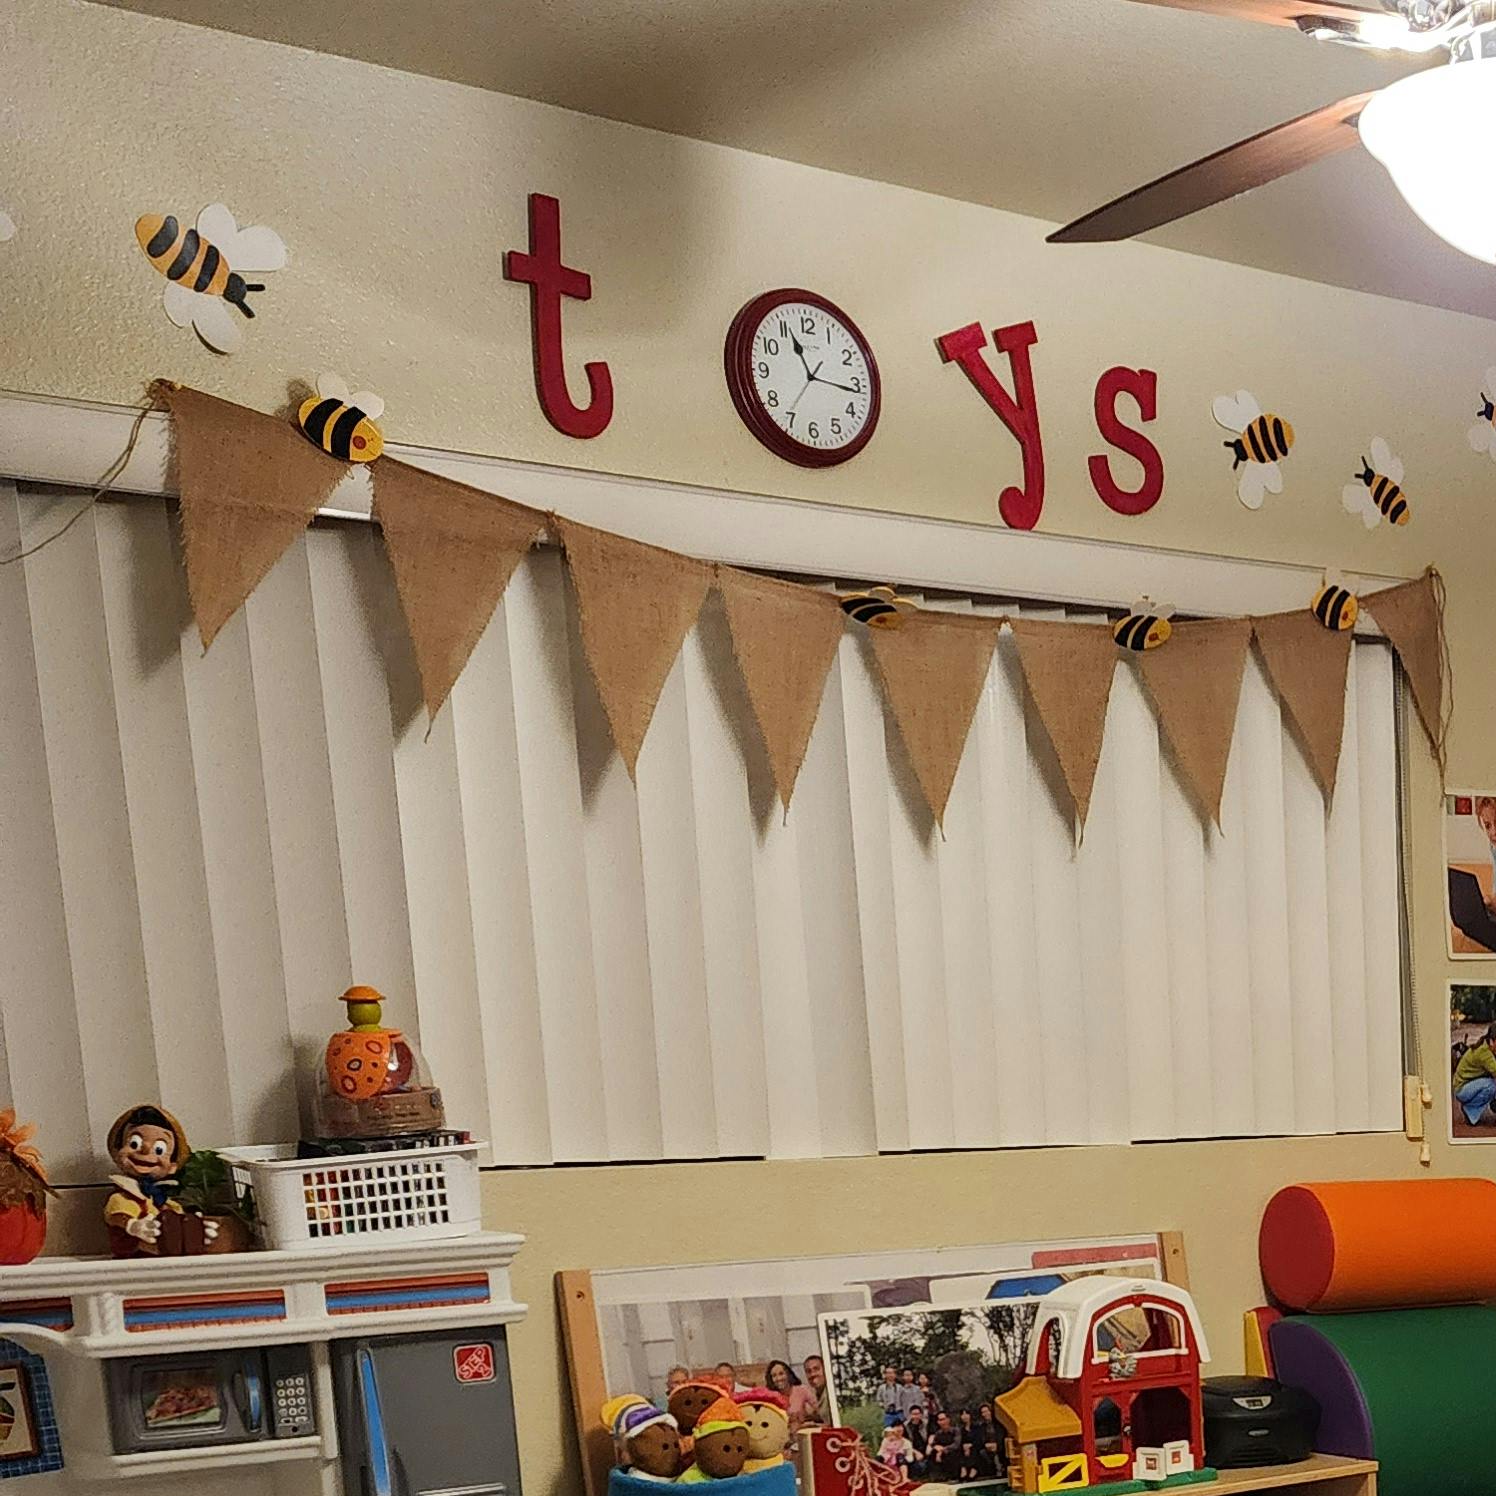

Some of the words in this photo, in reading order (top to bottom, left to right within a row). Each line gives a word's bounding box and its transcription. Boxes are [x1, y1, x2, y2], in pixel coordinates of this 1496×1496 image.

[801, 316, 816, 335] 12
[763, 336, 779, 356] 10
[842, 349, 853, 366] 2
[758, 361, 770, 379] 9
[850, 377, 861, 393] 3
[767, 390, 779, 408] 8
[845, 401, 857, 419] 4
[785, 411, 796, 429] 7
[830, 418, 842, 435] 5
[808, 421, 820, 440] 6
[459, 1347, 485, 1379] STEP
